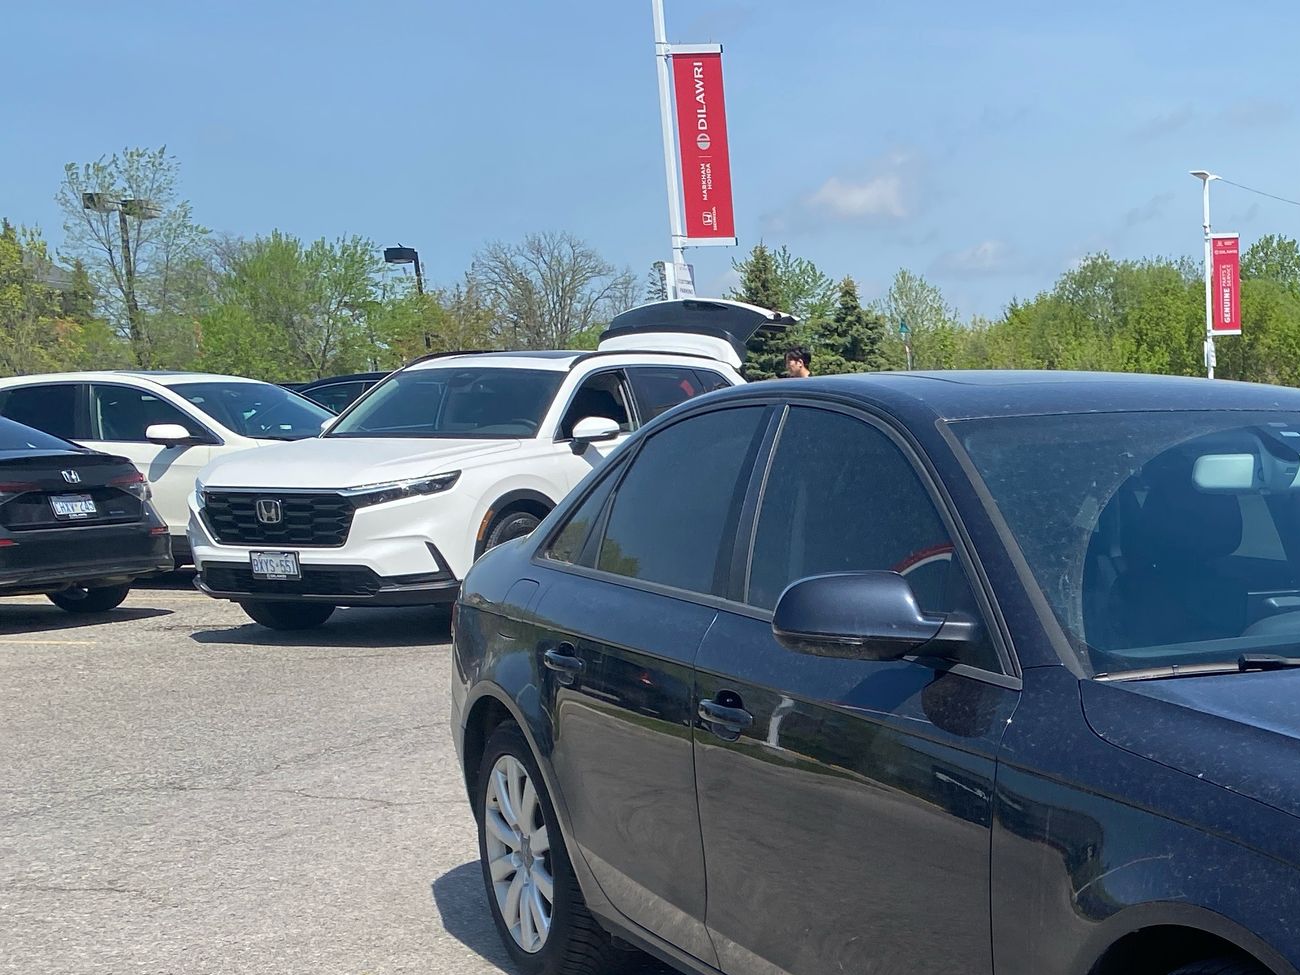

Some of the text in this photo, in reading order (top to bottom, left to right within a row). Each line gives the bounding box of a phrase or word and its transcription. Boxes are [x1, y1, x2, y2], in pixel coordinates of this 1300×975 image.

[693, 62, 708, 130] DILAWRI
[700, 163, 708, 200] MARKHAM
[1223, 288, 1231, 323] GENUINE
